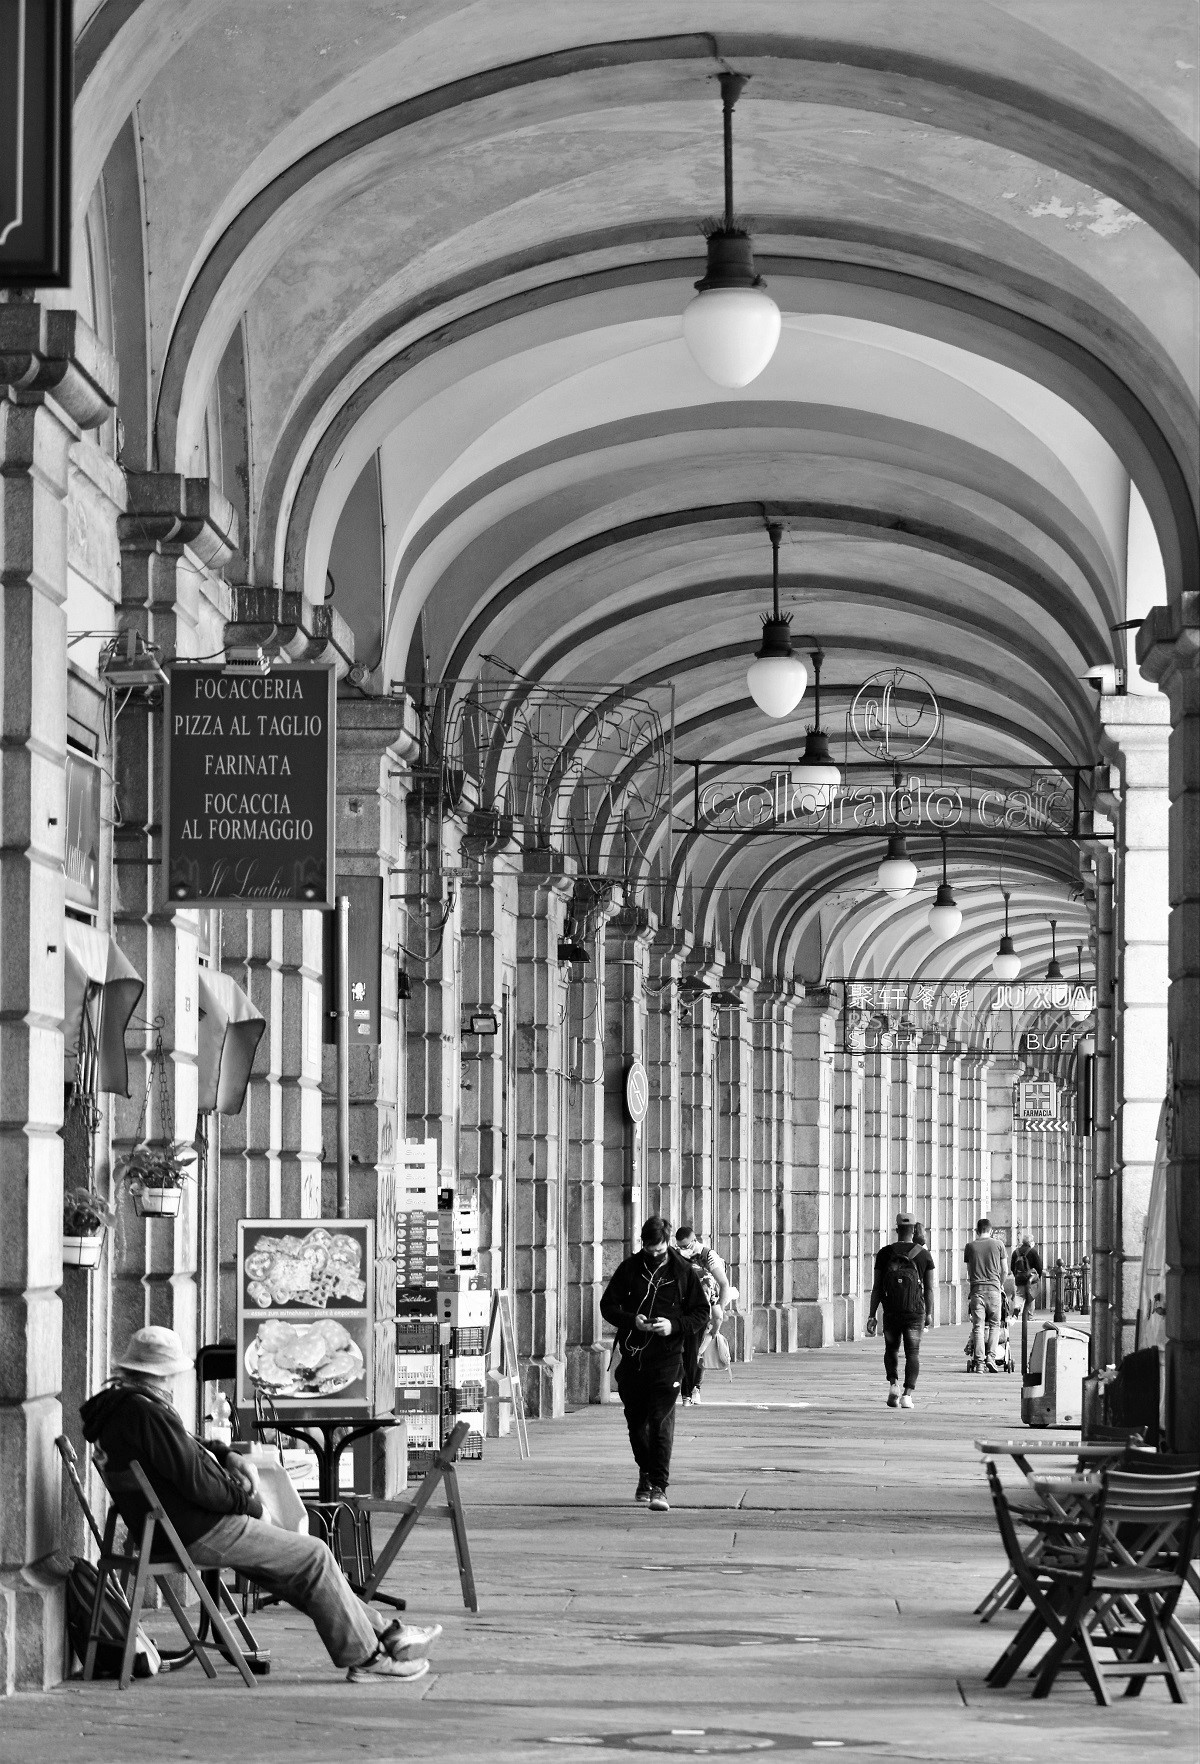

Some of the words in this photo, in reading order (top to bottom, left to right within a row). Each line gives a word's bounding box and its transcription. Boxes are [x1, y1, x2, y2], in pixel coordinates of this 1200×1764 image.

[194, 678, 304, 700] FOCACCERIA
[174, 715, 224, 736] PIZZA
[229, 715, 251, 736] AL
[257, 715, 322, 737] TAGLIO
[204, 754, 292, 776] FARINATA
[204, 793, 292, 815] FOCACCIA
[701, 772, 963, 828] colorado
[181, 818, 203, 840] AL
[208, 818, 313, 841] FORMAGGIO
[848, 1031, 919, 1050] SUSHI
[1023, 1109, 1053, 1118] FARMACIA
